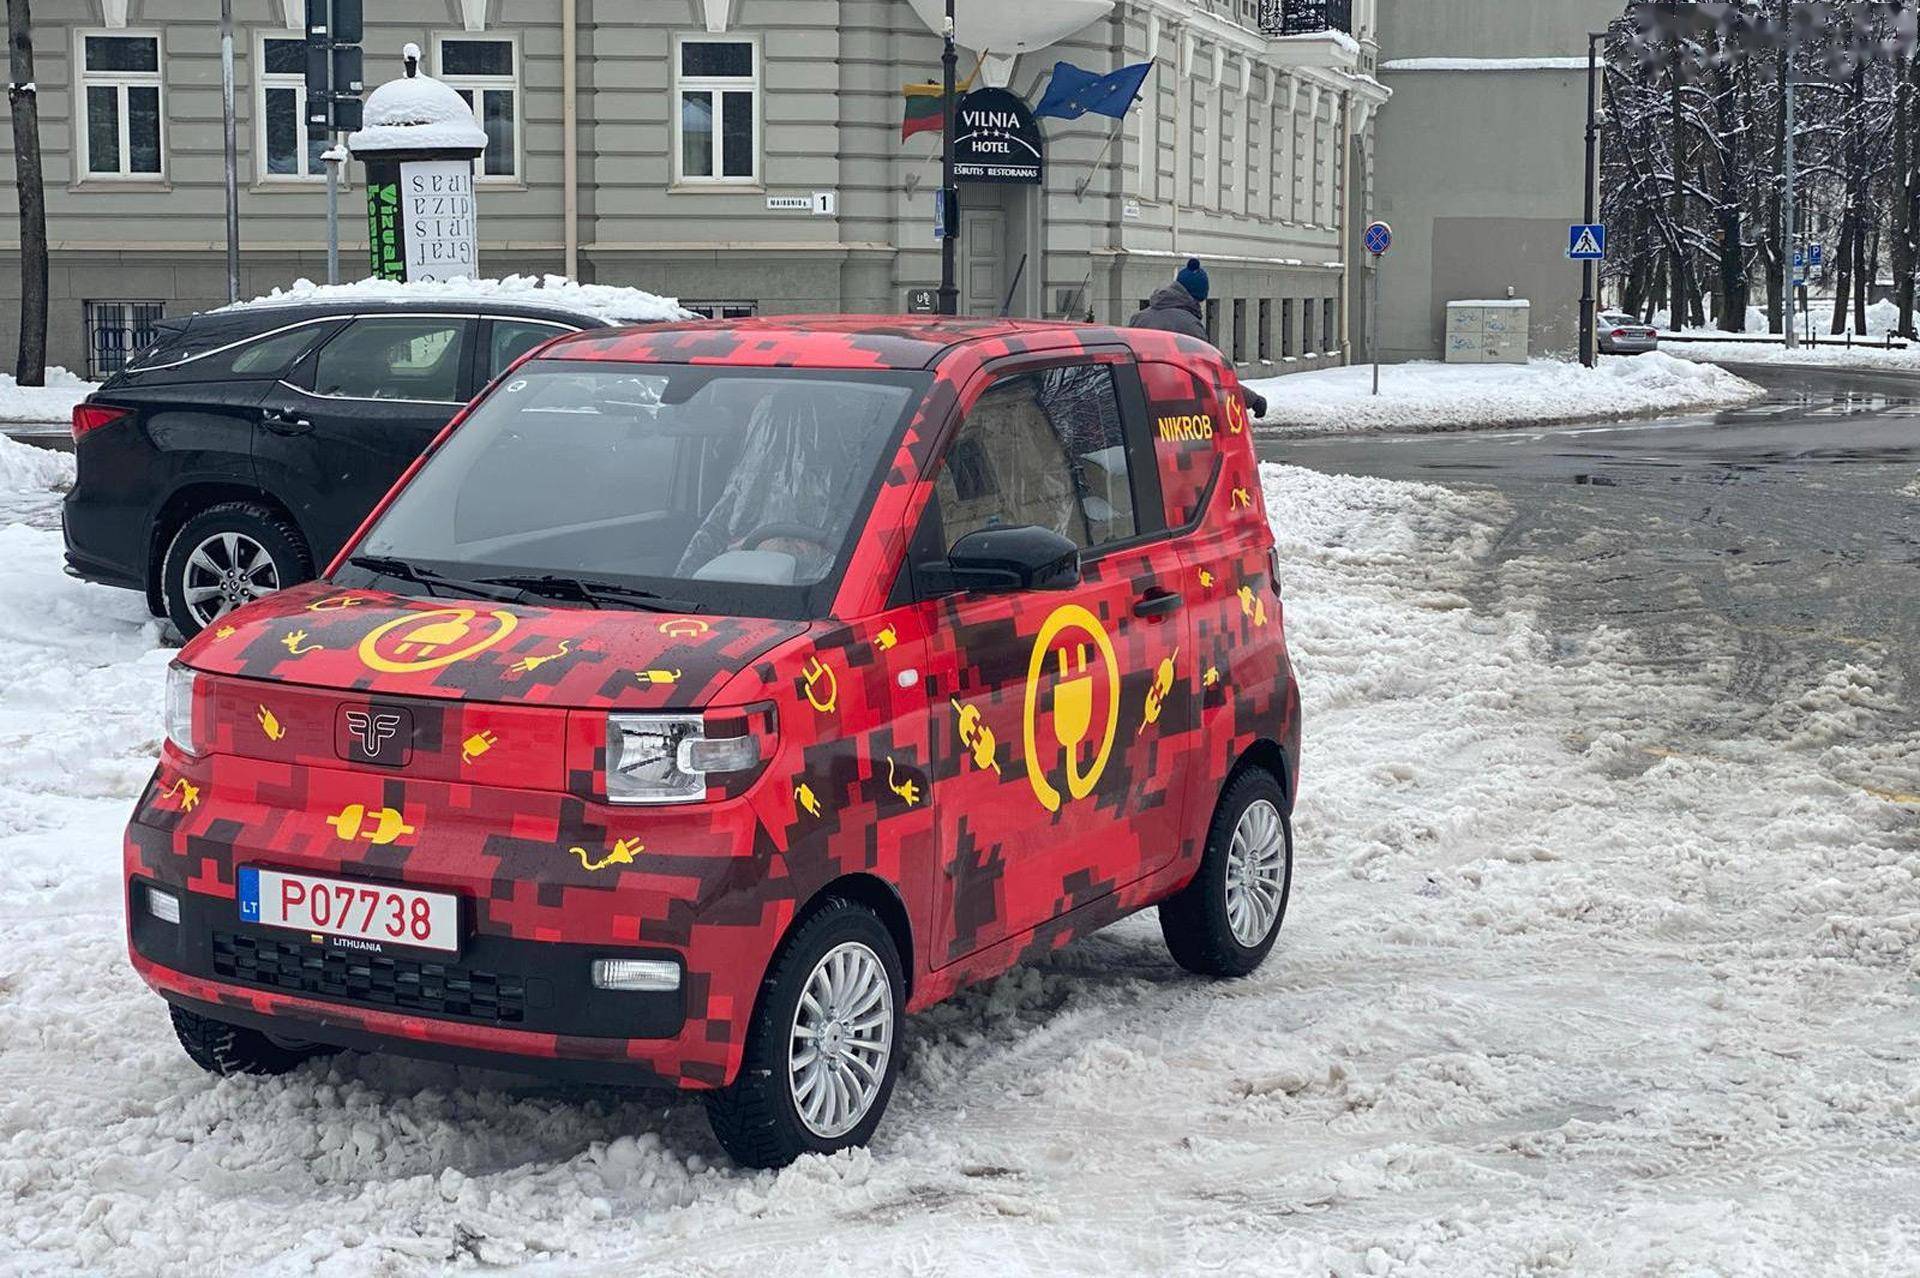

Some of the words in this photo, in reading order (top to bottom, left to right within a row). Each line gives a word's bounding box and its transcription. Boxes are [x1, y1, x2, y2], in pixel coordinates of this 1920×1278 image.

[962, 110, 1021, 128] VILNIA
[971, 141, 1011, 153] HOTEL
[953, 165, 984, 175] EŠBUTIS
[987, 168, 1038, 177] RESTORANAS
[820, 195, 827, 211] 1
[380, 184, 404, 281] Vizuali
[1812, 246, 1820, 257] P
[1793, 254, 1801, 265] P
[1158, 414, 1213, 442] NIKROB
[242, 899, 258, 914] LT
[281, 879, 432, 941] P07738
[333, 937, 382, 952] LITHUANIA
